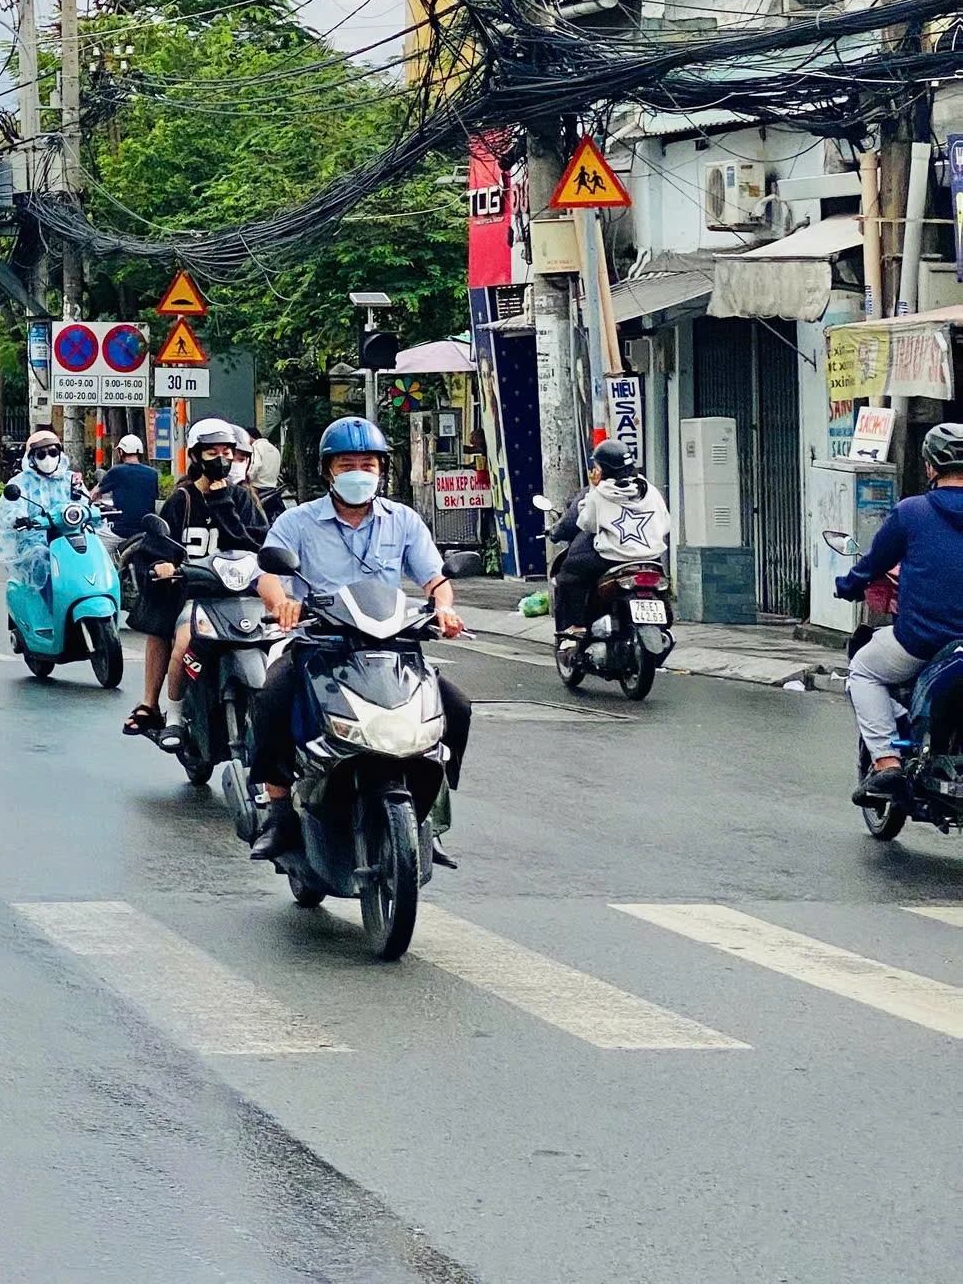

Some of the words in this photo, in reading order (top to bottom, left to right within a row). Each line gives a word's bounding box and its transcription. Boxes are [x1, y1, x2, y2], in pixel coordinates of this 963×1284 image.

[167, 374, 182, 390] 30
[185, 379, 197, 391] m
[611, 379, 636, 400] HIỆU
[469, 493, 485, 506] cái
